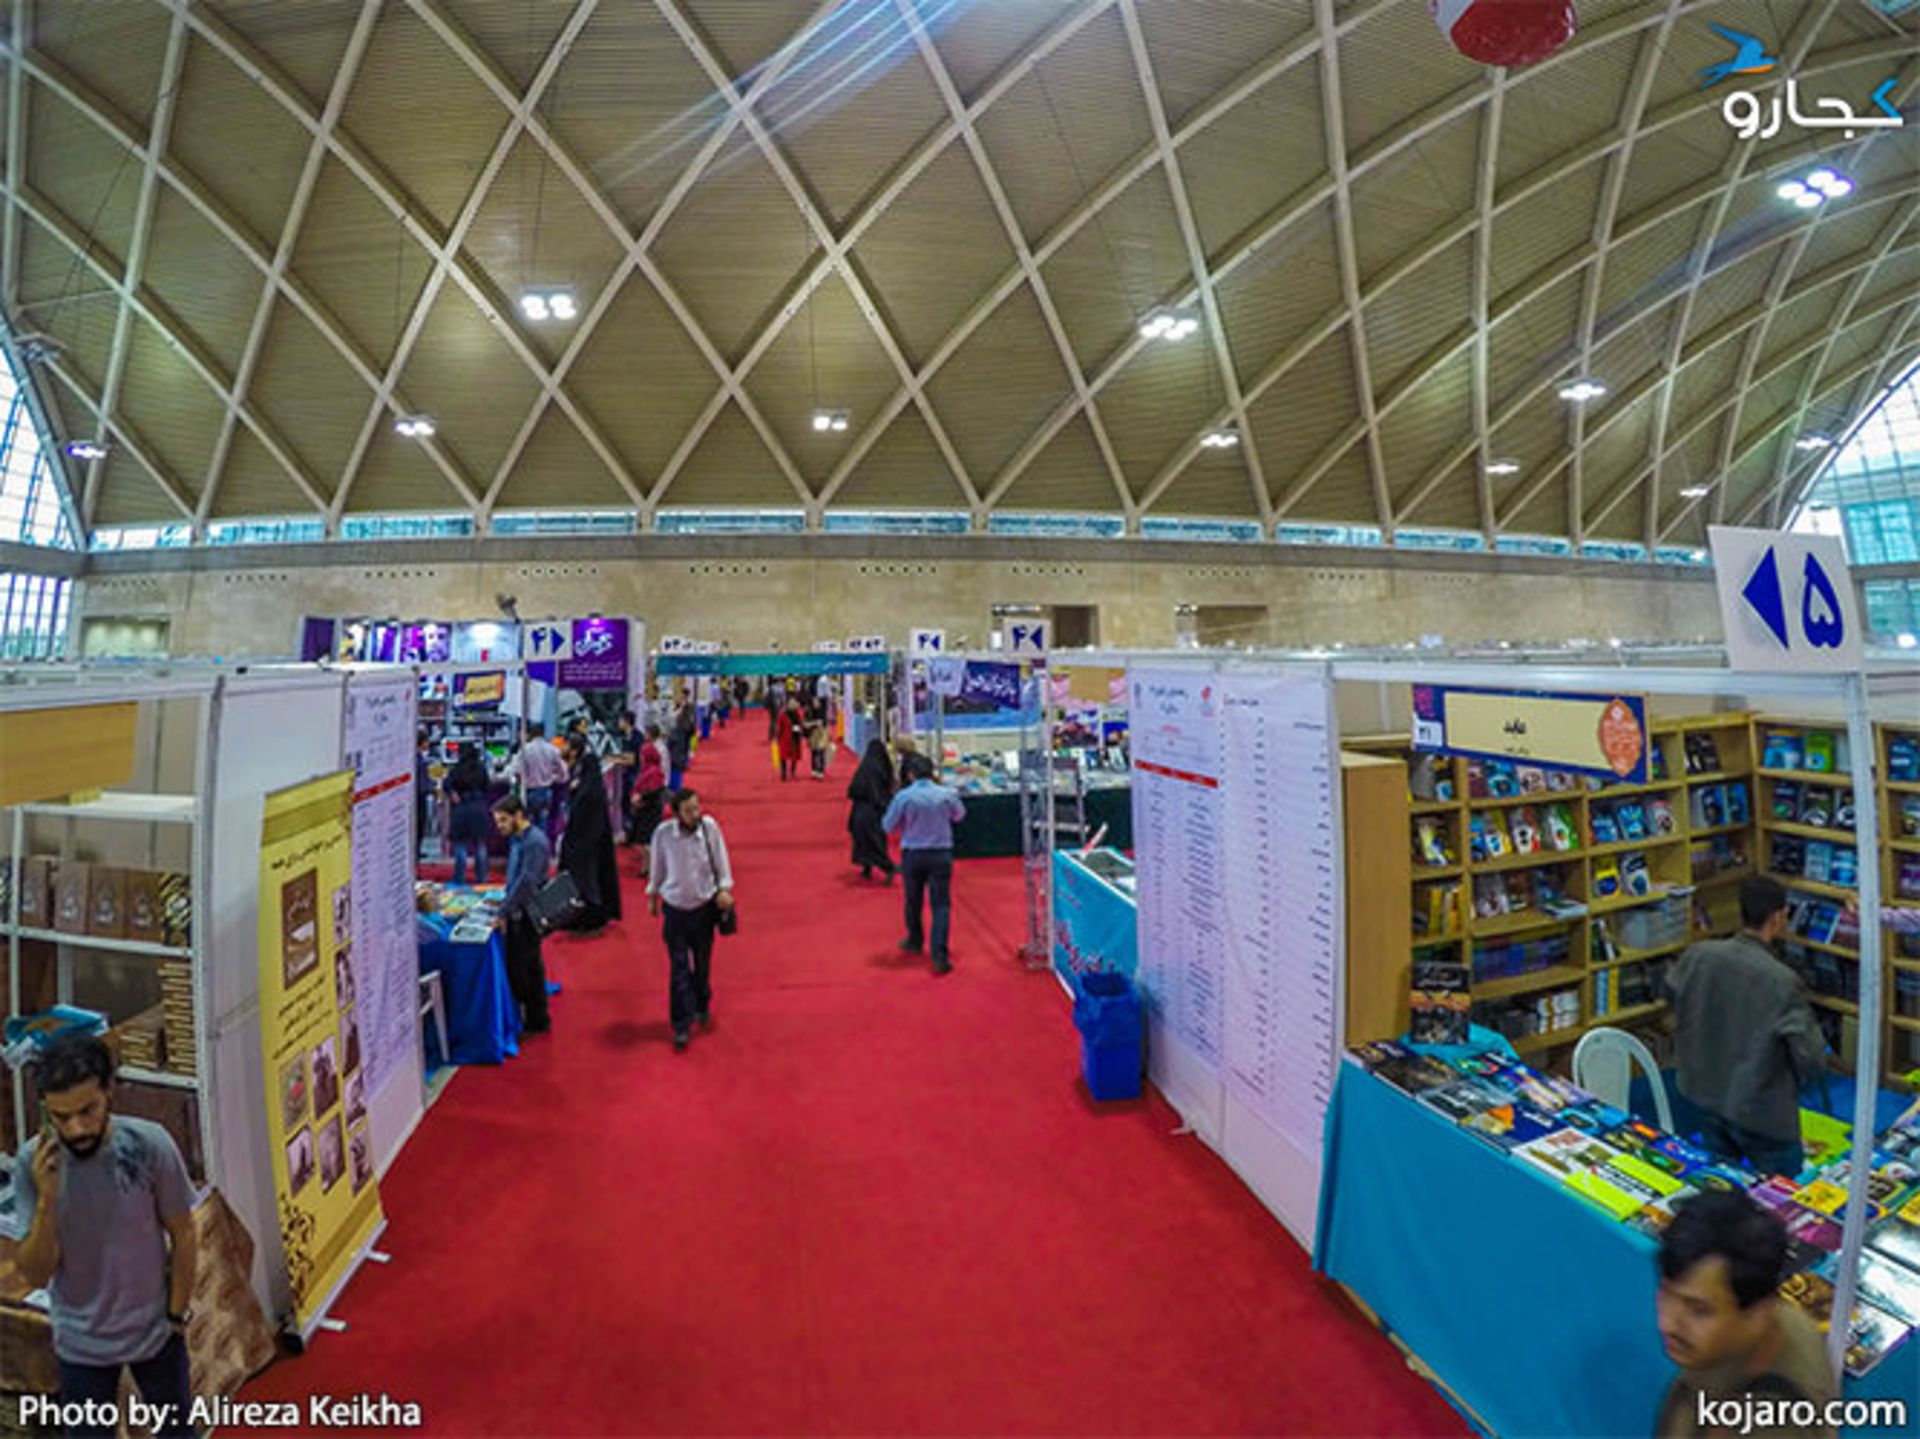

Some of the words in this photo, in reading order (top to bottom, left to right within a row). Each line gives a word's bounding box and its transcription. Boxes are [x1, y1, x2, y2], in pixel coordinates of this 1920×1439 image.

[1801, 552, 1844, 649] ۵
[531, 627, 548, 655] ۴
[1011, 624, 1028, 650] ۴
